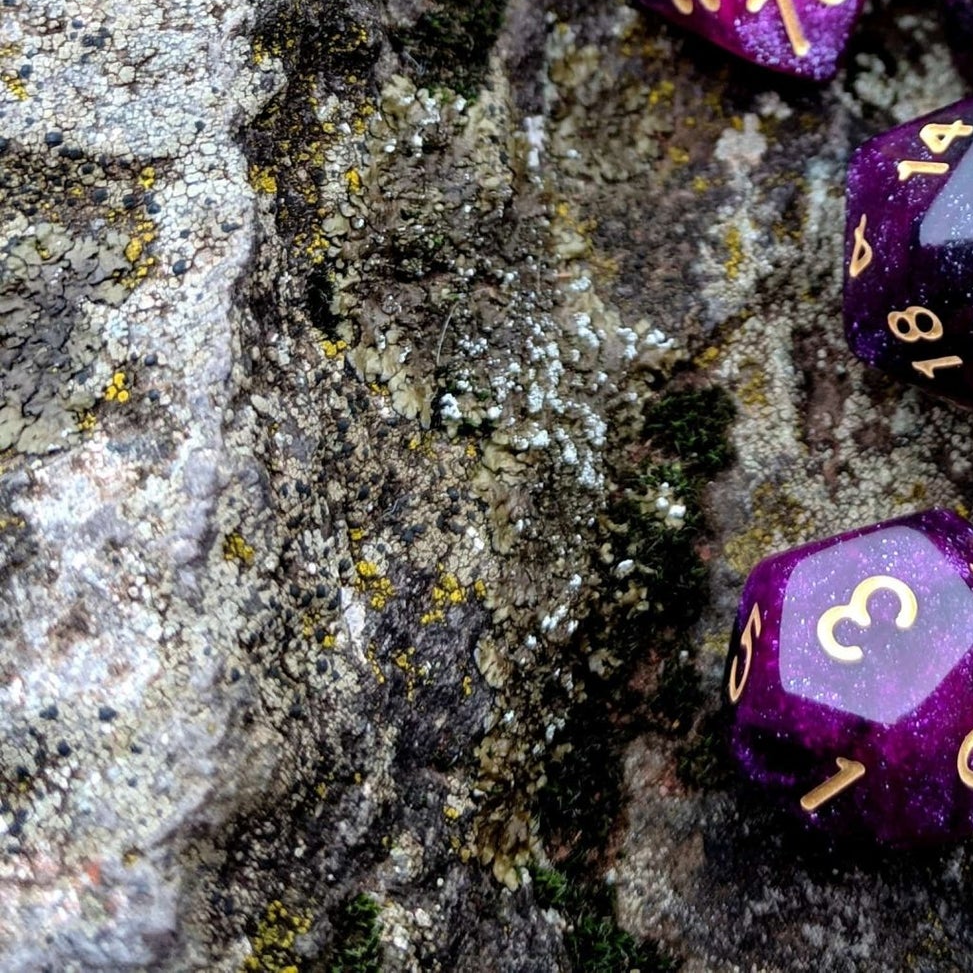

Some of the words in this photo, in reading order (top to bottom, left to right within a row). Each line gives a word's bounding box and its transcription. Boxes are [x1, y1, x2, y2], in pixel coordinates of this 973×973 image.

[887, 306, 963, 378] 18
[728, 602, 762, 702] 5
[816, 575, 918, 662] 3
[800, 756, 866, 812] 1
